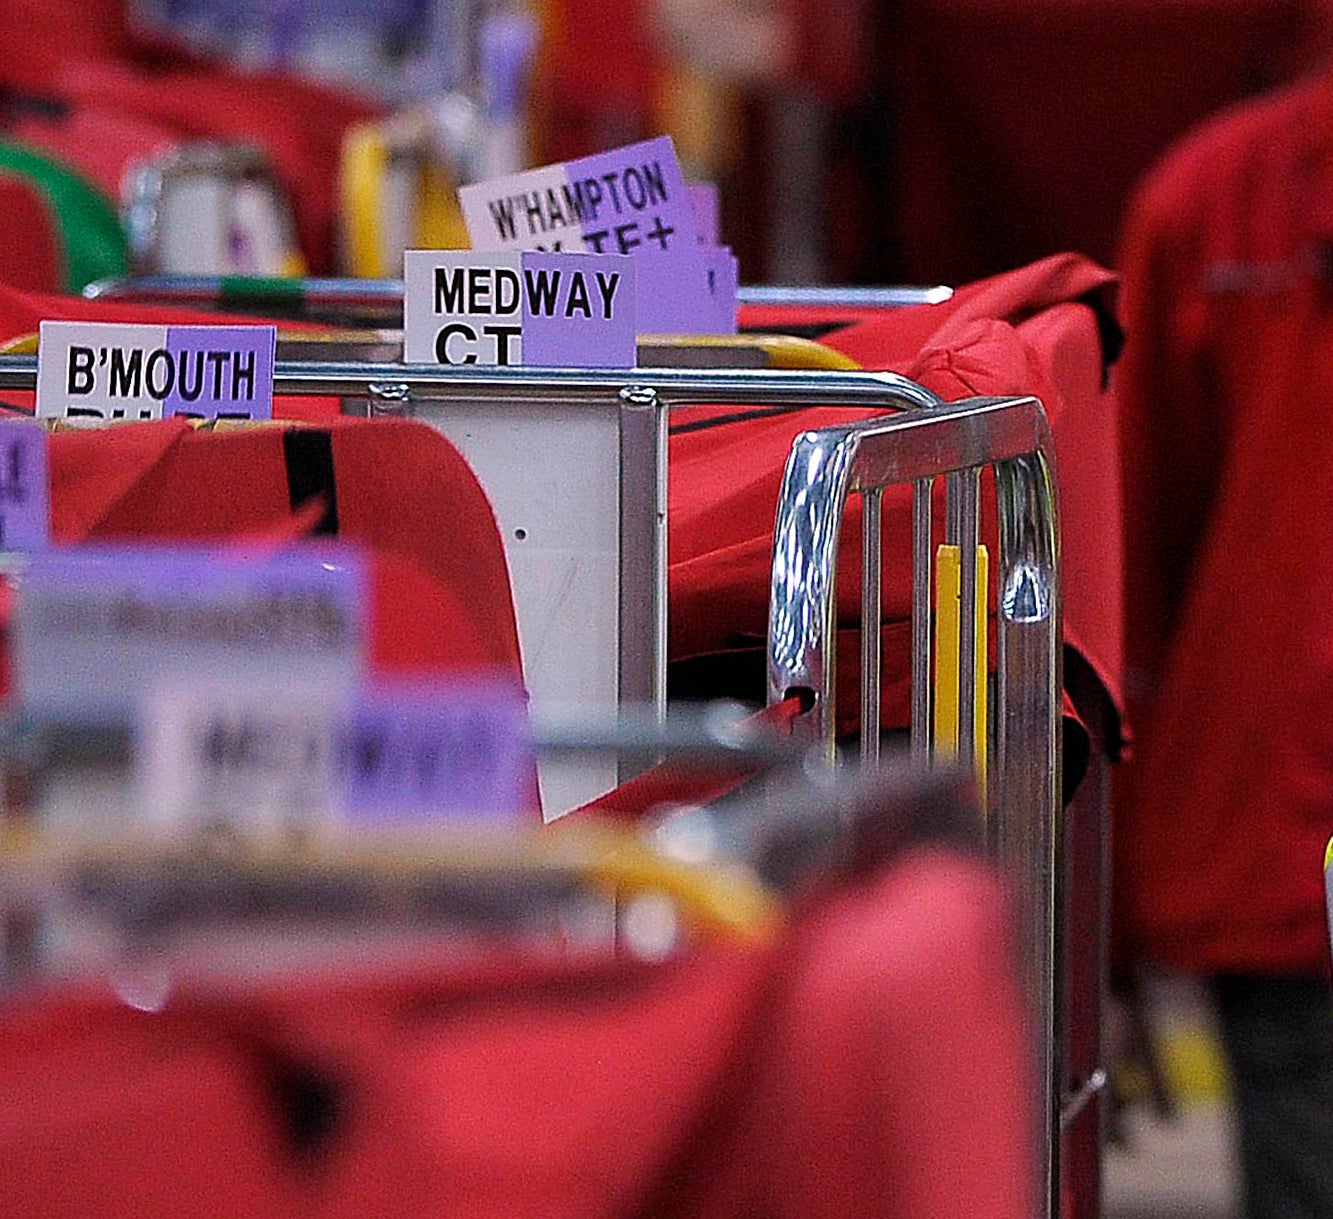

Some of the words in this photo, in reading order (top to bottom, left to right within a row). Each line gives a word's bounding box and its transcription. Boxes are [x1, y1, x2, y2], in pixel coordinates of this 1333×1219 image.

[489, 162, 668, 241] W'HAMPTON
[434, 268, 619, 319] MEDWAY
[435, 323, 522, 365] CT
[67, 346, 255, 401] B'MOUTH
